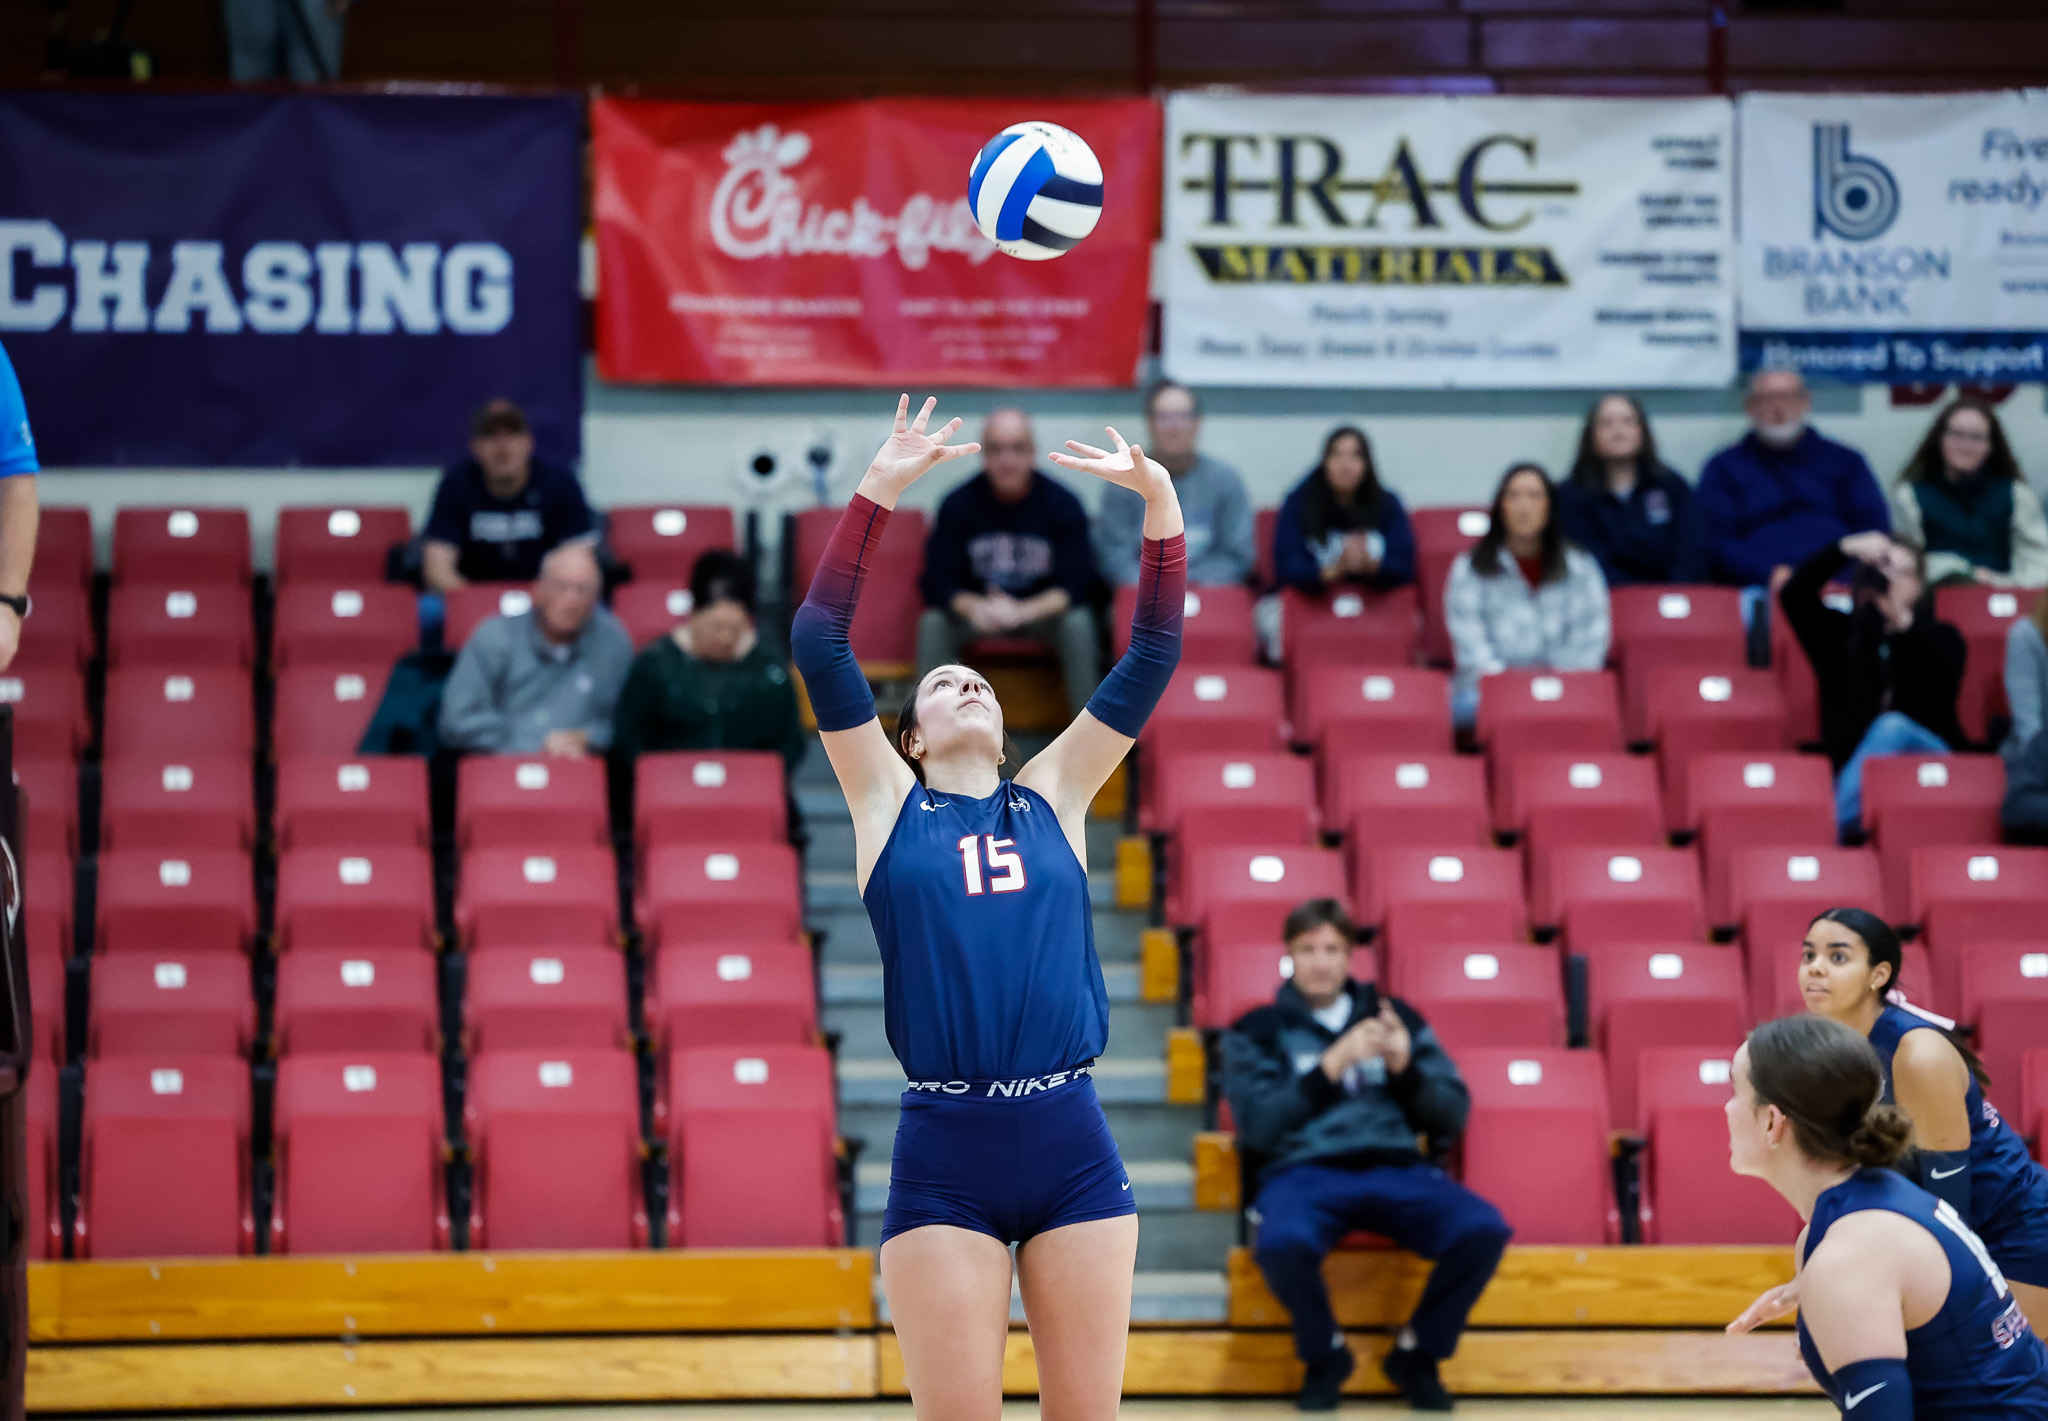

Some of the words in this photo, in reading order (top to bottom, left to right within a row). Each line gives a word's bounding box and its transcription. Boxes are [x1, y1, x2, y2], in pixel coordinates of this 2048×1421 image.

[1181, 133, 1539, 231] TRAC
[709, 150, 998, 270] Chick-fil
[0, 217, 515, 336] CHASING
[1219, 246, 1549, 283] MATERIALS
[1763, 248, 1951, 281] BRANSON
[1805, 284, 1910, 316] BANK
[1894, 339, 1927, 371] To
[1931, 339, 2043, 378] Support
[957, 834, 1028, 897] 15
[986, 1070, 1071, 1098] NIKE
